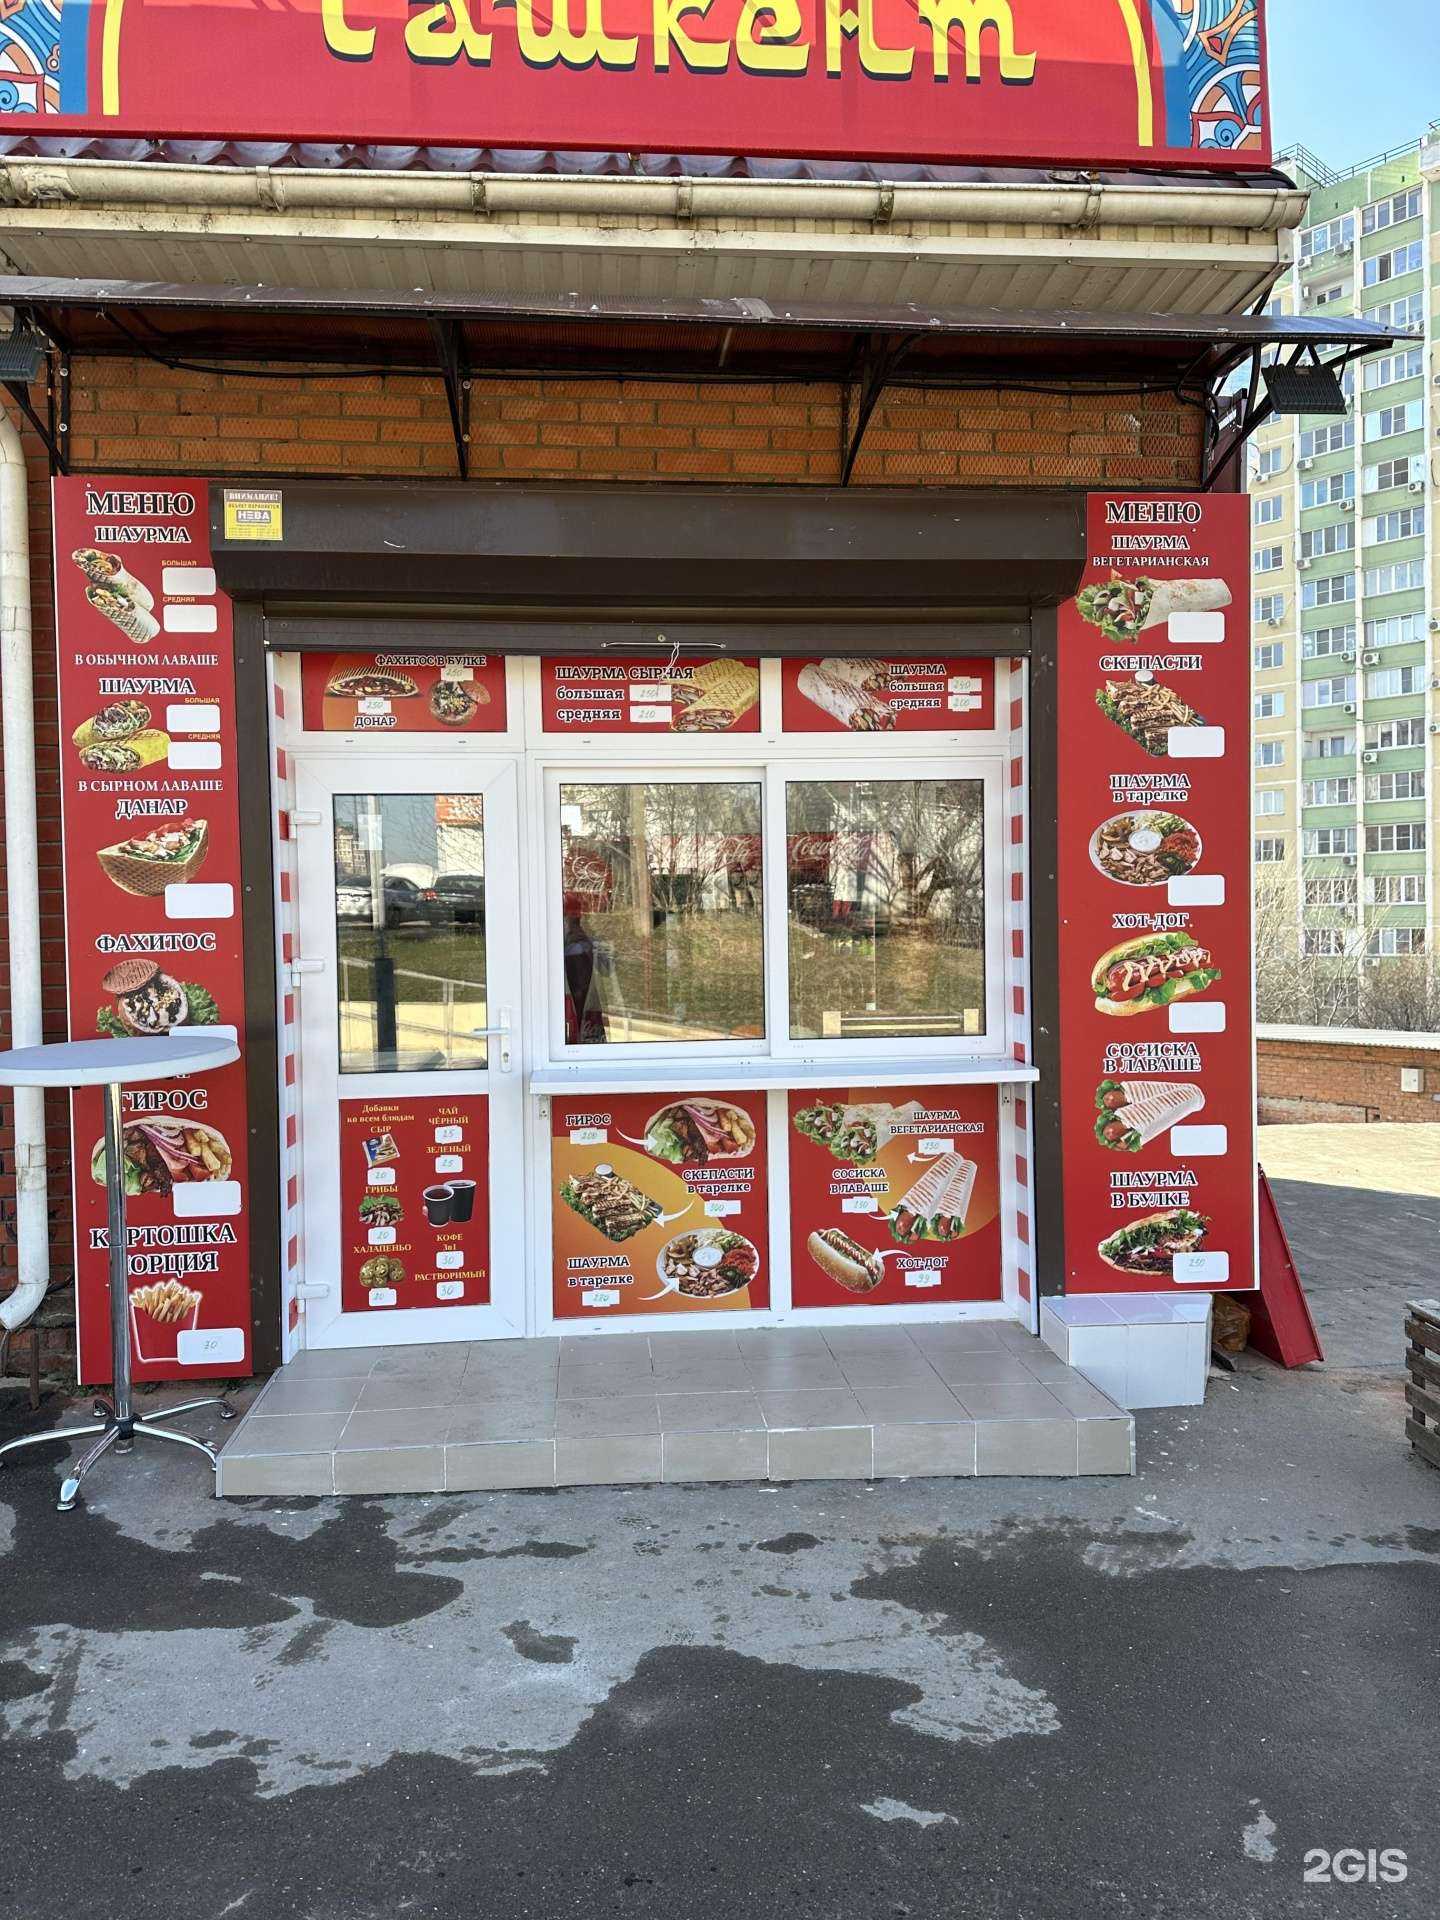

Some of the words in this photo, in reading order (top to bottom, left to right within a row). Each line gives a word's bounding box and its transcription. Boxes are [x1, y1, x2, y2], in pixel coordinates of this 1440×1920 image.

[86, 490, 195, 516] МЕНЮ
[1105, 501, 1201, 523] МЕНЮ
[95, 526, 191, 543] ШАУРМА
[1112, 535, 1190, 550] ШАУРМА
[1093, 556, 1209, 566] ВЕГЕТАРИАНСКАЯ
[75, 654, 83, 665] В
[86, 653, 159, 666] ОБЫЧНОМ
[161, 653, 219, 666] ЛАВАШЕ
[375, 654, 435, 667] ФАХИТОС
[436, 655, 445, 666] В
[446, 655, 486, 667] БУЛКЕ
[1099, 654, 1202, 671] СКЕПАСТИ
[555, 666, 627, 679] ШАУРМА
[629, 666, 694, 680] СЫРНАЯ
[890, 664, 946, 675] ШАУРМА
[99, 677, 195, 695] ШАУРМА
[557, 684, 624, 700] большая
[890, 680, 944, 691] большая
[889, 698, 940, 710] средняя
[355, 715, 397, 728] ДОНАР
[557, 708, 621, 722] средняя
[78, 780, 87, 791] В
[90, 780, 158, 792] СЫРНОМ
[160, 779, 224, 791] ЛАВАШЕ
[1110, 773, 1190, 789] ШАУРМА
[1113, 790, 1123, 802] в
[1126, 789, 1188, 805] тарелке
[115, 798, 187, 819] ДАНАР
[1112, 912, 1189, 931] ХОТ-ДОГ
[95, 932, 216, 953] ФАХИТОС
[1106, 1042, 1198, 1058] СОСИСКА
[1103, 1058, 1116, 1073] В
[1119, 1056, 1201, 1073] ЛАВАШЕ
[362, 1104, 399, 1114] Добавки
[439, 1106, 458, 1114] ЧАЙ
[913, 1110, 960, 1120] ШАУРМА
[382, 1114, 415, 1122] блюдам
[565, 1113, 611, 1127] ГИРОС
[370, 1125, 391, 1133] СЫР
[890, 1123, 984, 1134] ВЕГЕТАРИАНСКАЯ
[682, 1168, 754, 1180] СКЕПАСТИ
[832, 1168, 886, 1178] СОСИСКА
[1110, 1170, 1198, 1188] ШАУРМА
[365, 1185, 398, 1194] ГРИБЫ
[688, 1184, 698, 1194] в
[698, 1183, 750, 1195] тарелке
[830, 1183, 841, 1194] В
[841, 1182, 889, 1193] ЛАВАШЕ
[1111, 1193, 1125, 1208] В
[1127, 1191, 1190, 1207] БУЛКЕ
[90, 1223, 237, 1249] КРТОШКА
[436, 1233, 463, 1242] КОФЕ
[353, 1243, 412, 1253] ХАЛАПЕНЬО
[127, 1251, 219, 1278] ОРЦИЯ
[568, 1256, 630, 1269] ШАУРМА
[897, 1256, 948, 1270] ХОТ-ДОГ
[415, 1270, 486, 1281] РАСТВОРИМЫЙ
[568, 1276, 579, 1287] в
[581, 1274, 633, 1289] тарелке
